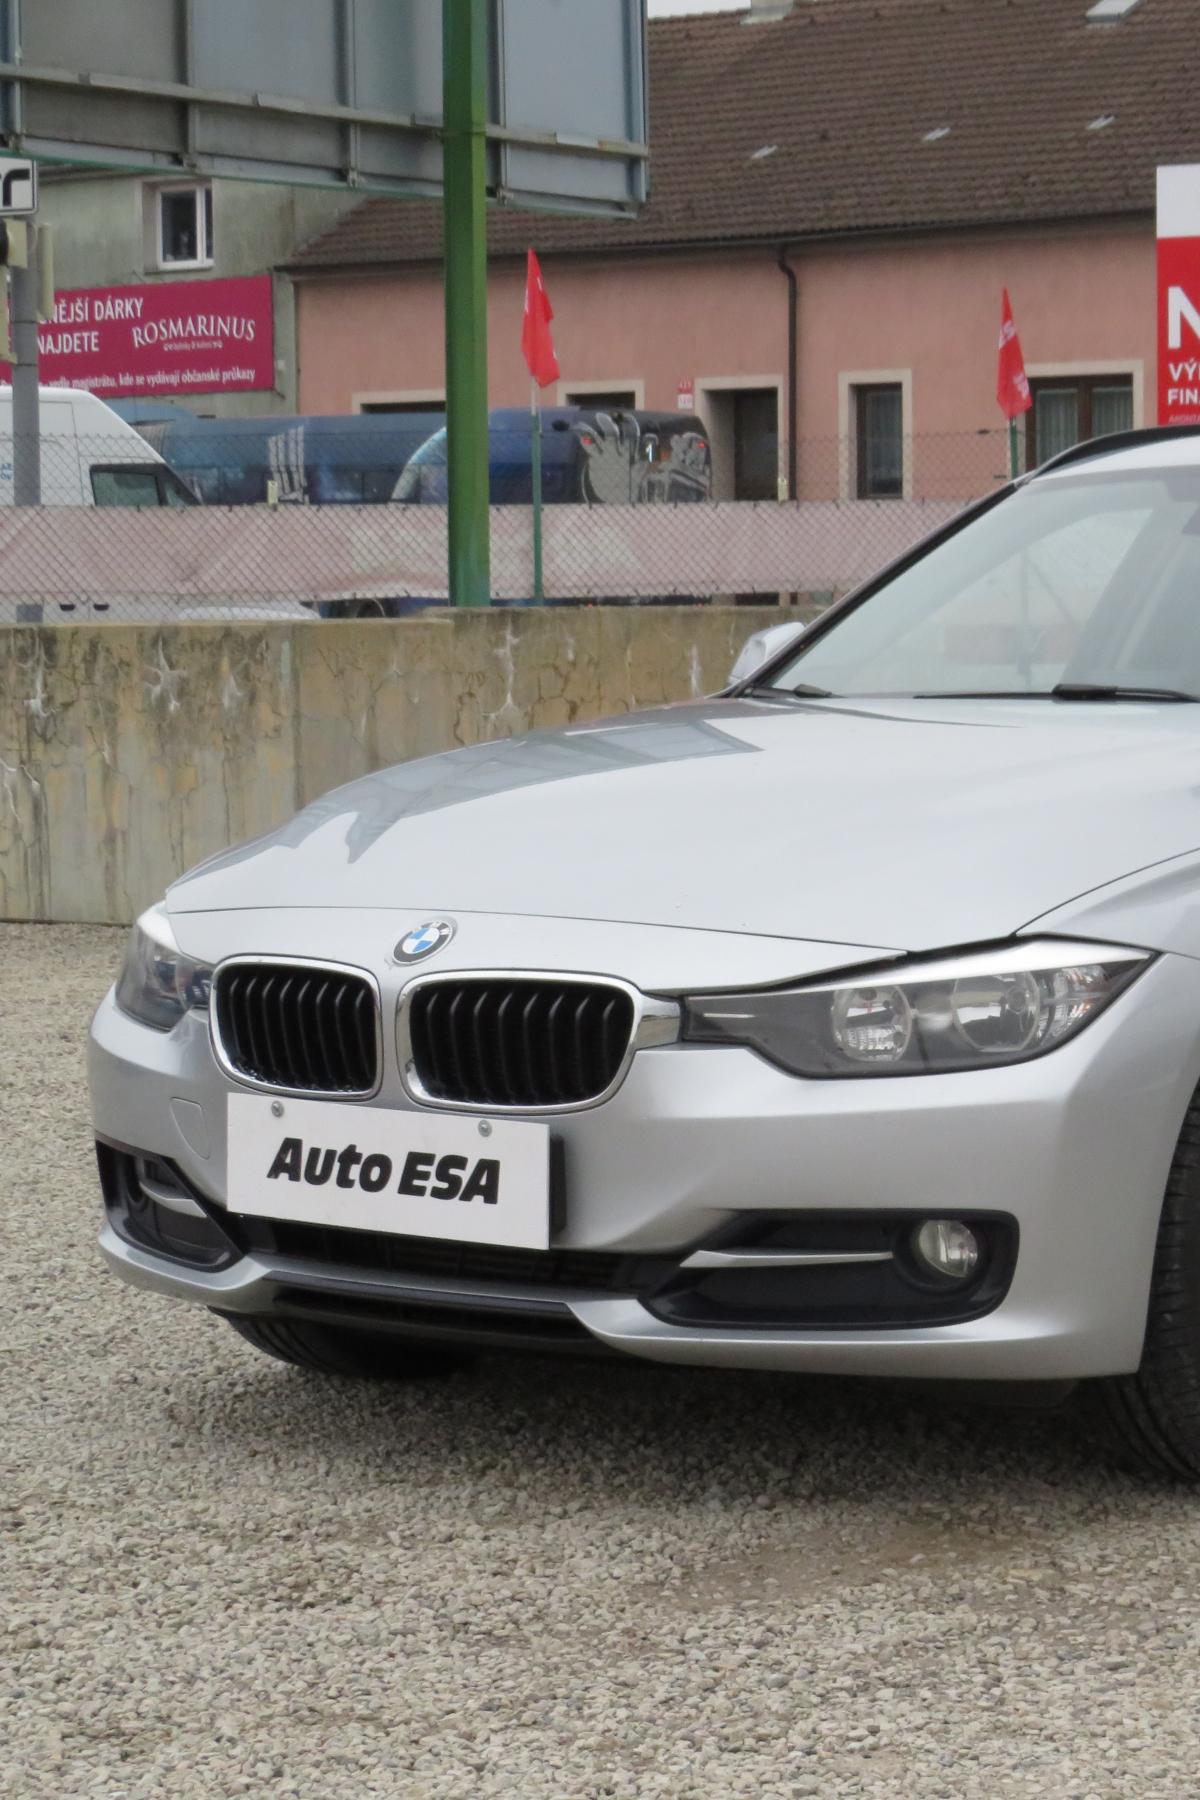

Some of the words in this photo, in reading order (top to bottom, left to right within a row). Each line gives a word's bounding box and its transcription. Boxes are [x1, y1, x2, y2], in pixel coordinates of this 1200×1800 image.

[40, 297, 89, 324] NĚJŠÍ
[94, 296, 143, 321] DÁRKY
[37, 331, 100, 355] NAJDETE
[132, 315, 255, 348] ROSMARINUS
[267, 1137, 393, 1193] Auto
[397, 1151, 501, 1205] ESA
